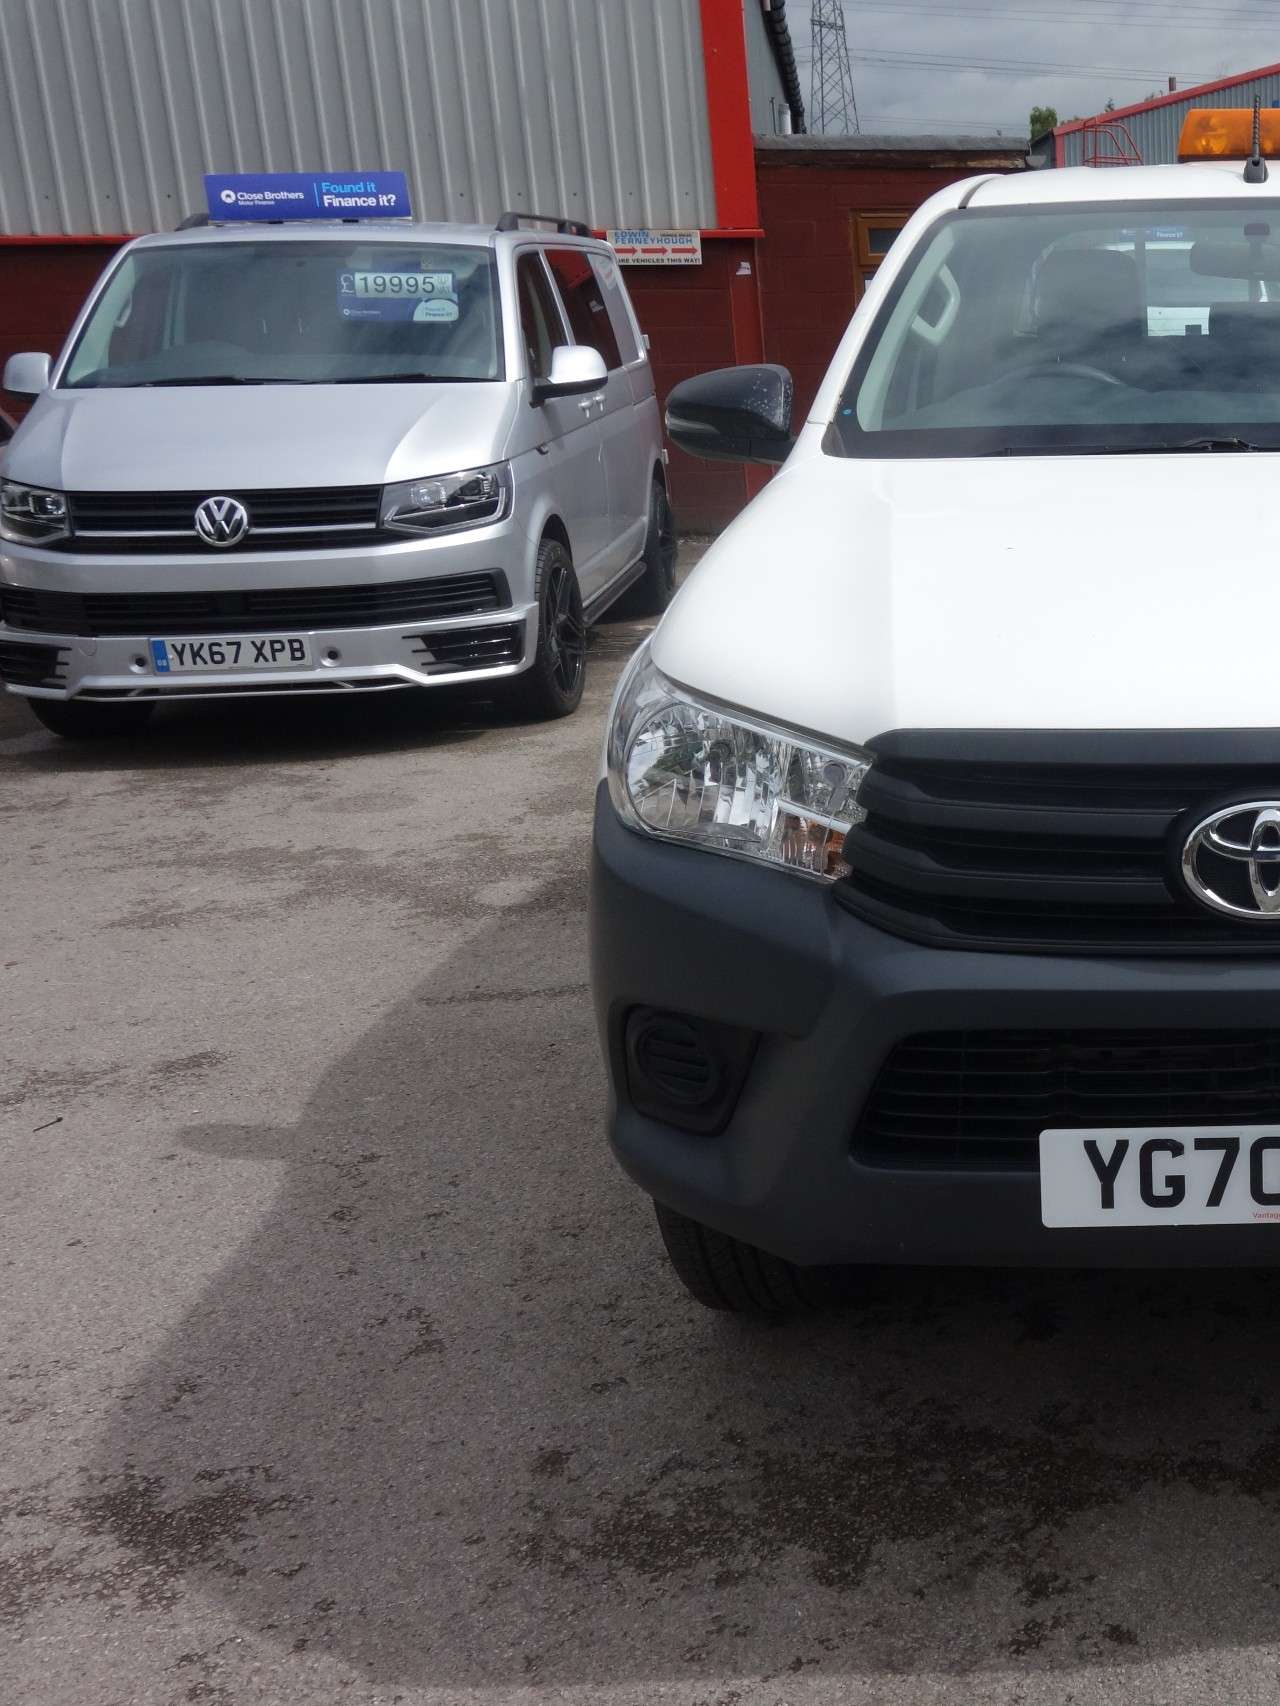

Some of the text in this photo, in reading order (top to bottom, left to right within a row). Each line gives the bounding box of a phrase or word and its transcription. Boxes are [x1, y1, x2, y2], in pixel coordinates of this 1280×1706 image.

[321, 181, 377, 193] Found it
[237, 191, 304, 200] Close Brothers
[323, 193, 397, 207] Finance it?
[171, 638, 306, 666] YK67 XPB
